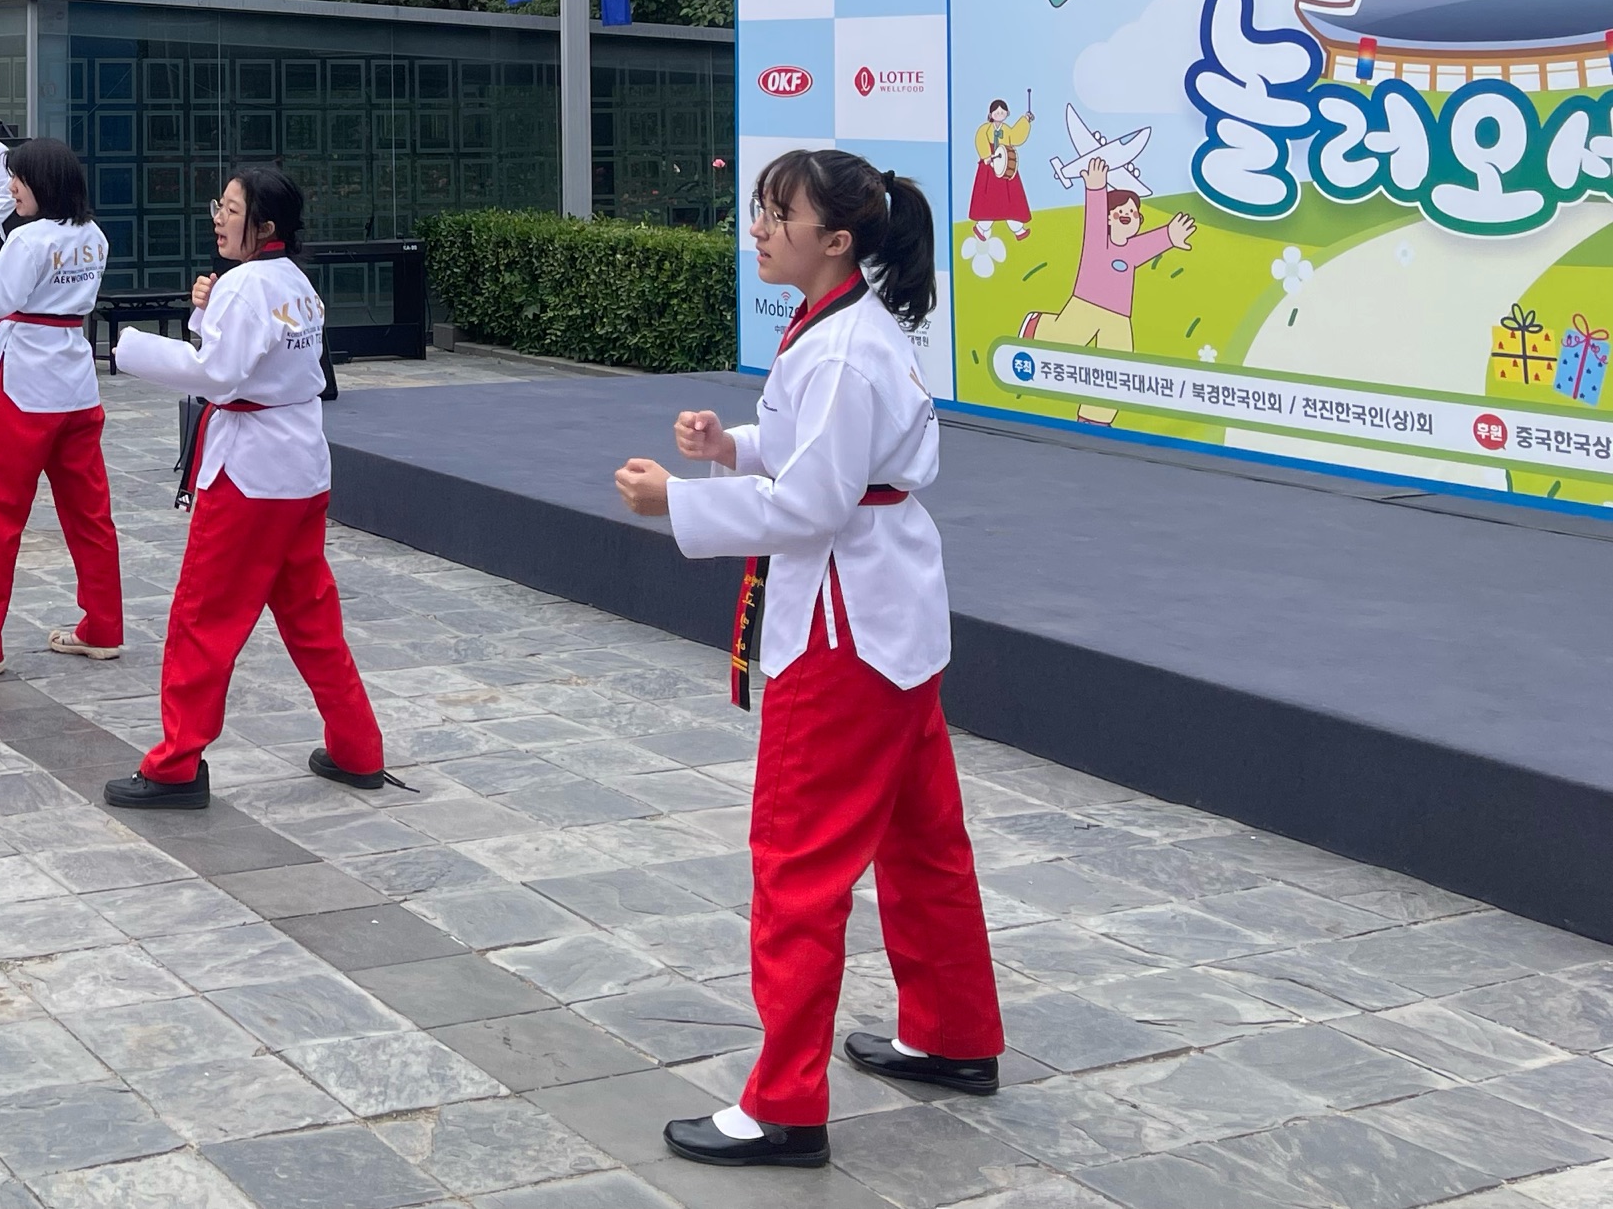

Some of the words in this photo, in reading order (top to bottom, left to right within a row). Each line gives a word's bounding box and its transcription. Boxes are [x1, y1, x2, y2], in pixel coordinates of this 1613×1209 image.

[767, 72, 803, 92] OKF
[879, 71, 925, 84] LOTTE
[879, 85, 925, 93] WELLFOOD
[52, 244, 105, 270] KISB
[1014, 359, 1033, 374] 주최
[1040, 361, 1174, 398] 주중국대한민국대사관
[1192, 382, 1283, 414] 북경한국인회
[1302, 397, 1434, 435] 천진한국인(상)회
[1477, 422, 1503, 442] 후원
[1516, 425, 1613, 460] 중국한국상
